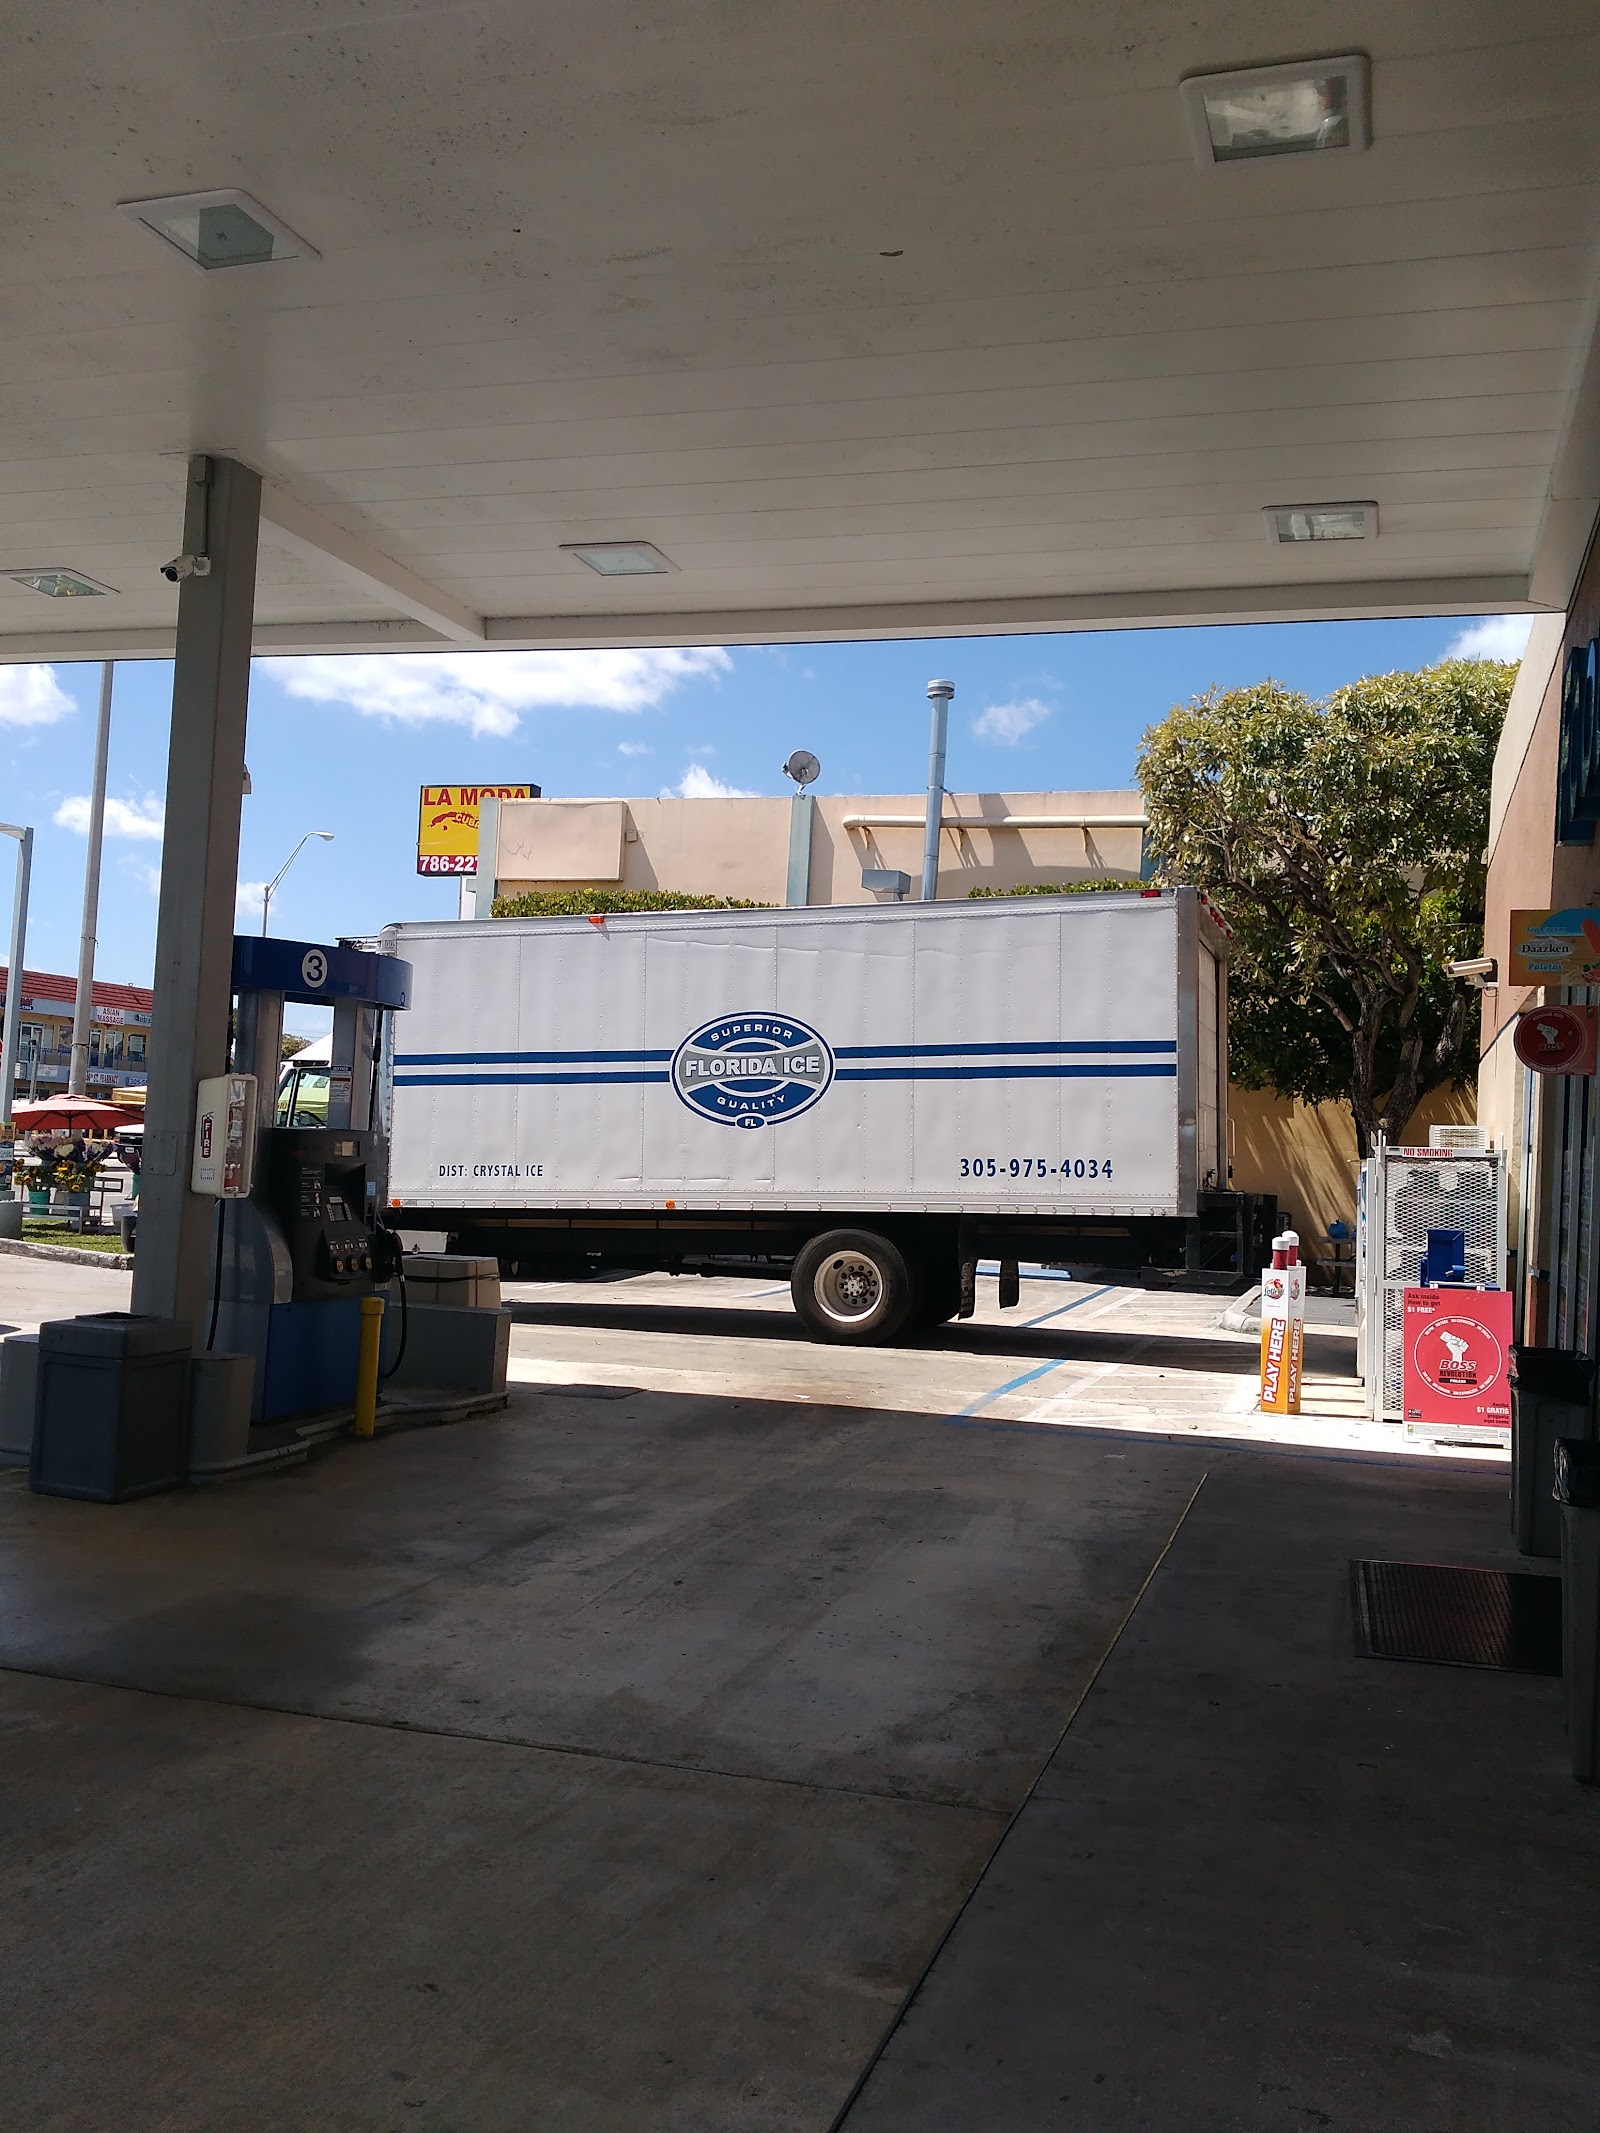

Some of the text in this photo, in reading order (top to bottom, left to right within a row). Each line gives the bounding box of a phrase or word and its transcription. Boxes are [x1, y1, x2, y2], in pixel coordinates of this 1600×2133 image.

[423, 788, 453, 806] LA
[1522, 944, 1570, 953] Däazken
[306, 955, 323, 982] 3
[1528, 962, 1562, 970] Paletas
[98, 1014, 124, 1025] MASSAGE
[102, 1008, 120, 1016] ASIAN
[710, 1024, 793, 1042] SUPERIOR
[685, 1056, 821, 1077] FLORIDA ICE
[716, 1094, 786, 1110] QUALITY
[744, 1118, 757, 1127] FL
[1403, 1148, 1453, 1157] NO SMOKING
[439, 1164, 544, 1177] DIST: CRYSTAL ICE
[960, 1158, 1113, 1179] 305-975-4034
[1268, 1318, 1286, 1362] HERE
[1292, 1318, 1300, 1360] HERE
[1440, 1360, 1477, 1371] BOSS
[1263, 1361, 1280, 1403] PLAY
[1440, 1370, 1476, 1378] REVOLUTION
[1289, 1363, 1298, 1403] PLAY
